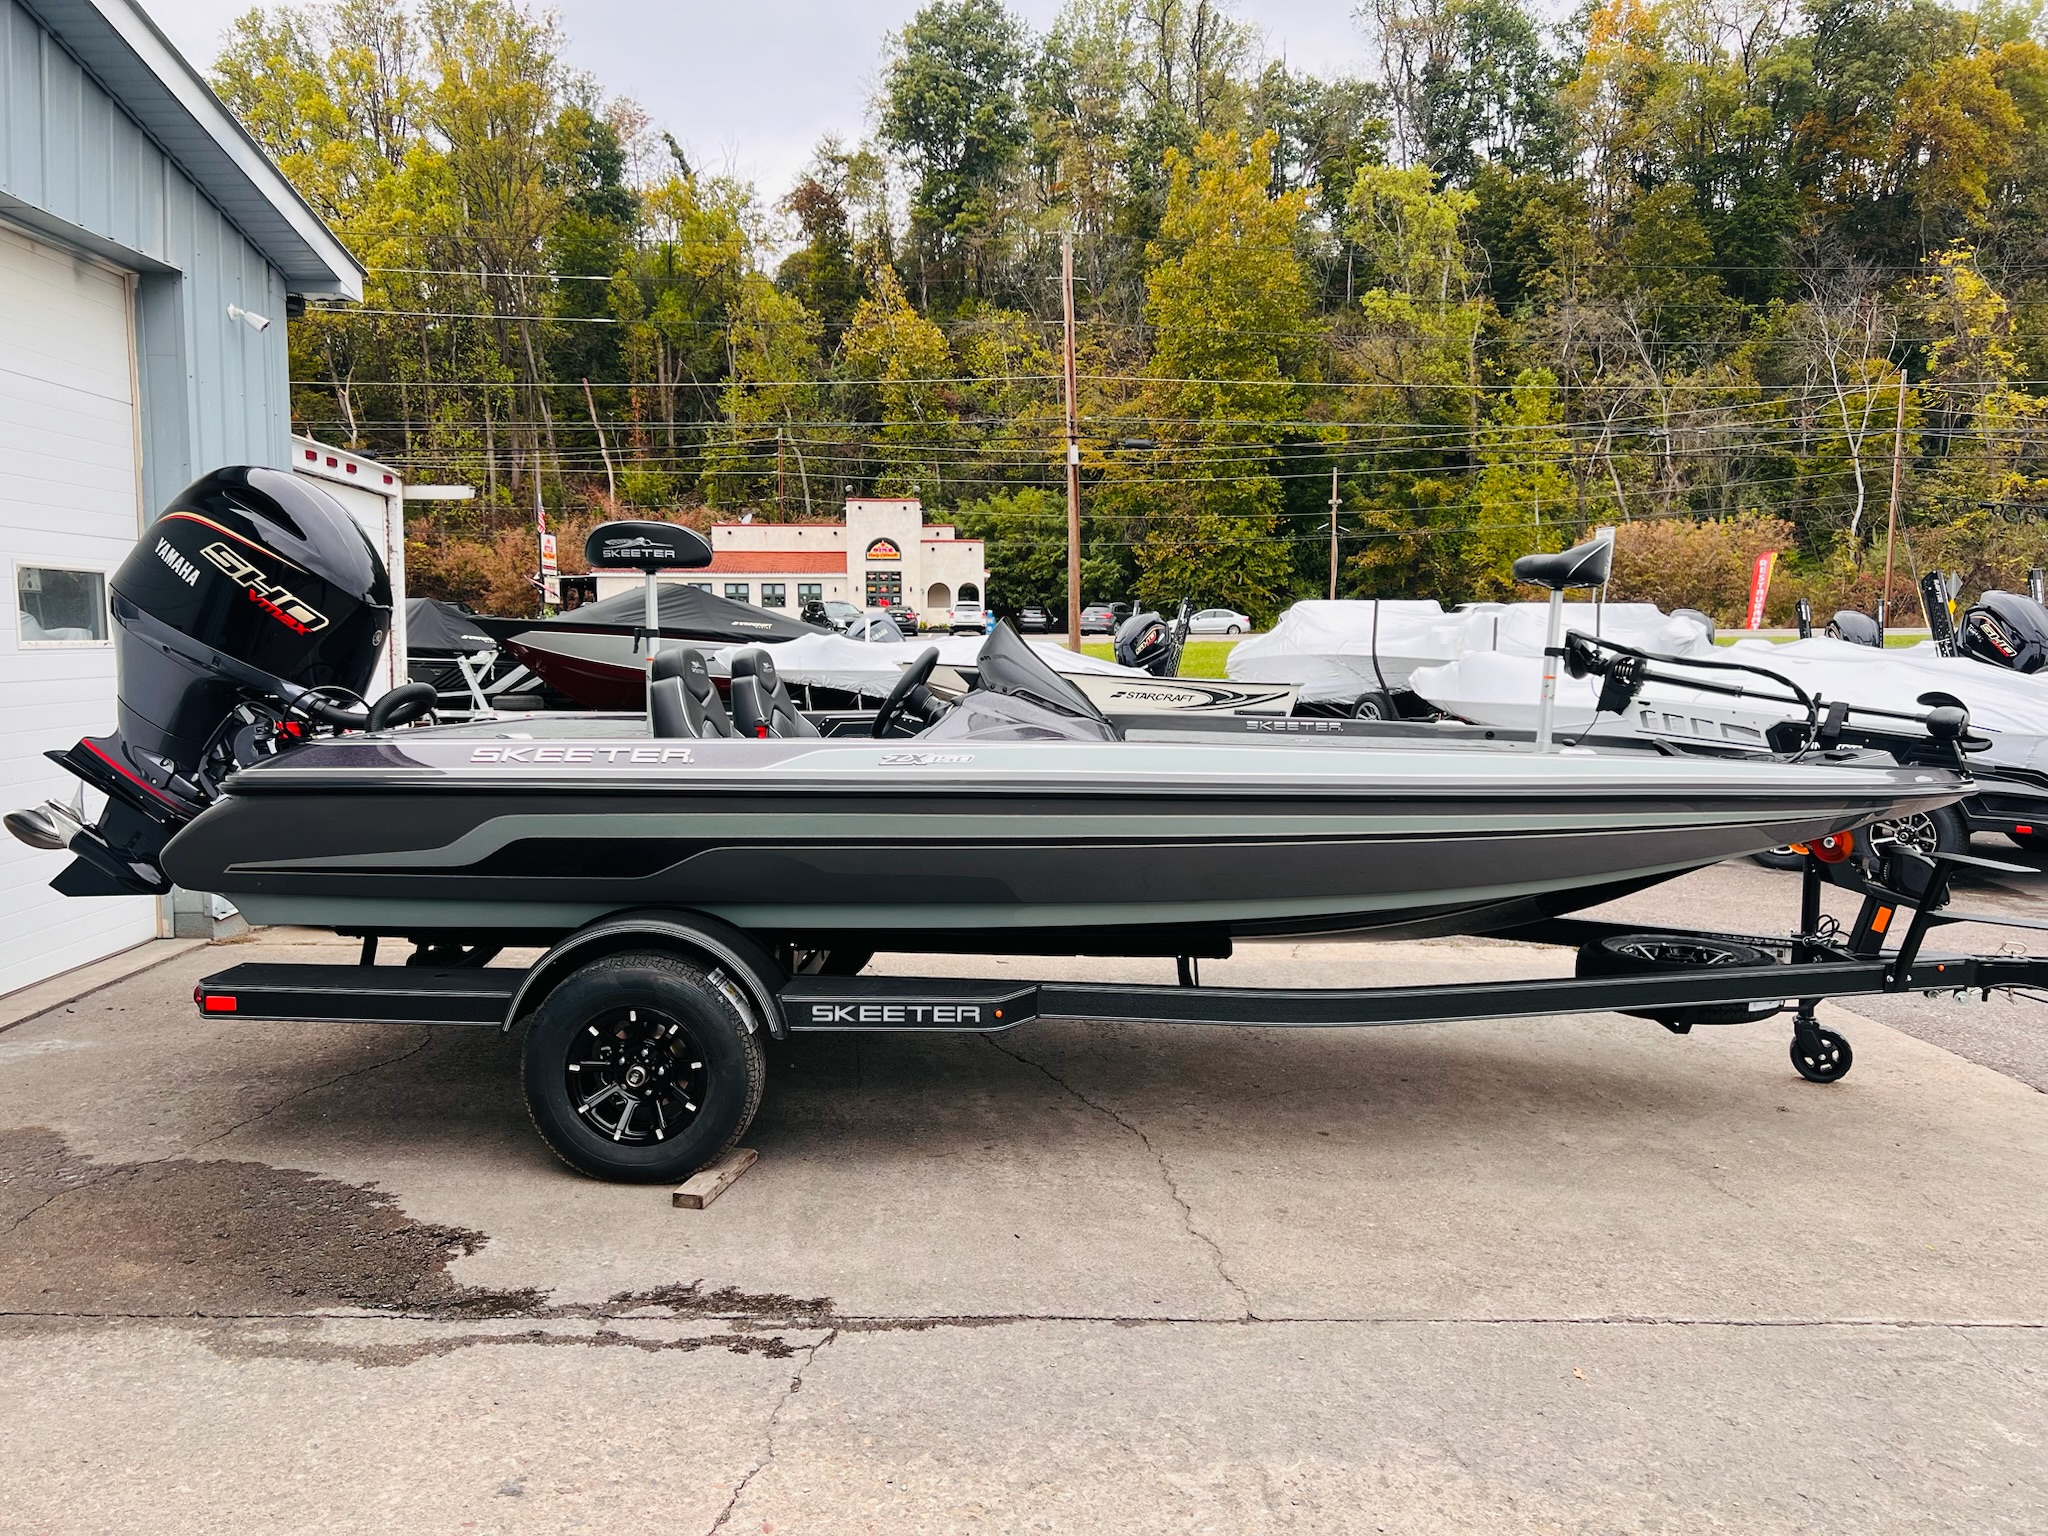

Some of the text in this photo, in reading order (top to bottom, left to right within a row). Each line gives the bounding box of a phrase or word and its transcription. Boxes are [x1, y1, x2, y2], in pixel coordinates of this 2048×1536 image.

[154, 537, 201, 587] YAMAHA
[602, 549, 676, 558] SKEETER
[200, 542, 329, 632] SHO
[1751, 559, 1768, 631] RESTAURANT
[1980, 623, 2018, 657] SHO
[1126, 692, 1196, 702] STARCRAFT
[812, 1005, 981, 1023] SKEETER
